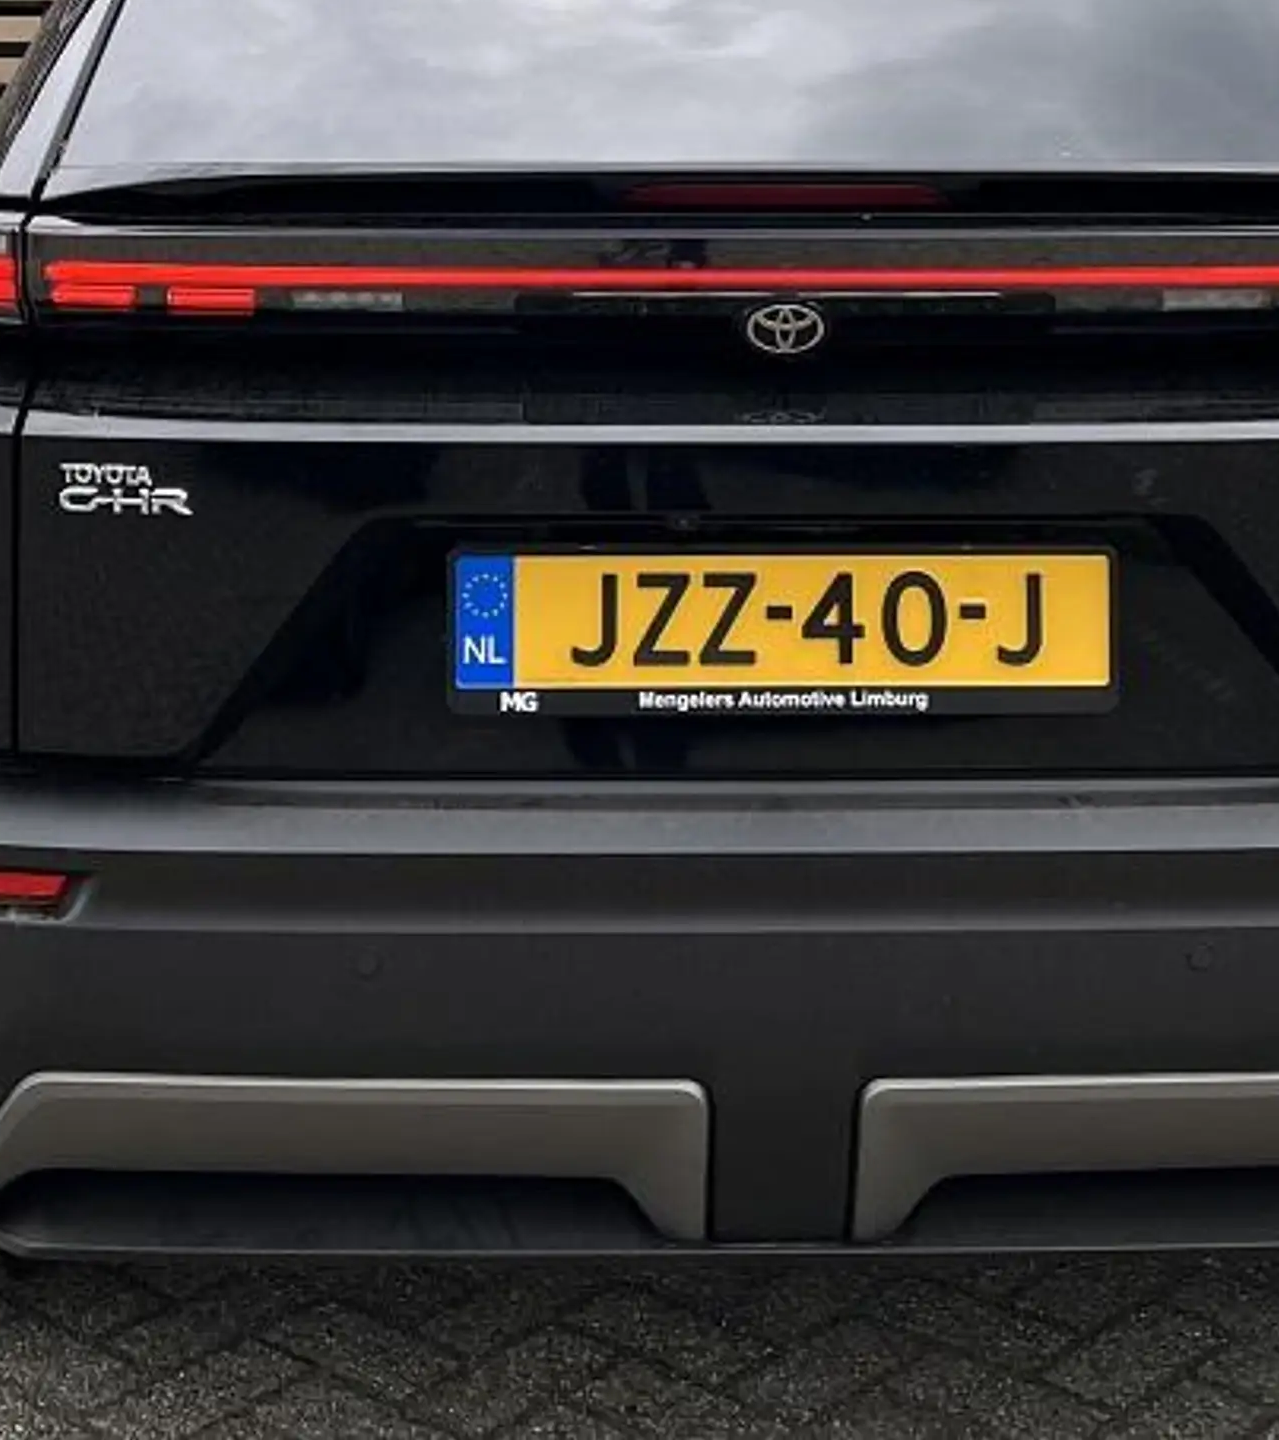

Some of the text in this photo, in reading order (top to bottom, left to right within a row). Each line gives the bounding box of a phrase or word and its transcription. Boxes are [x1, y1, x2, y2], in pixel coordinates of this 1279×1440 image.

[59, 462, 153, 486] TOYOTA
[59, 486, 194, 516] C-HR
[571, 571, 1043, 667] JZZ-40-J
[462, 635, 507, 665] NL
[500, 691, 539, 712] MG
[639, 690, 929, 712] Mengelers Automotive Limburg
